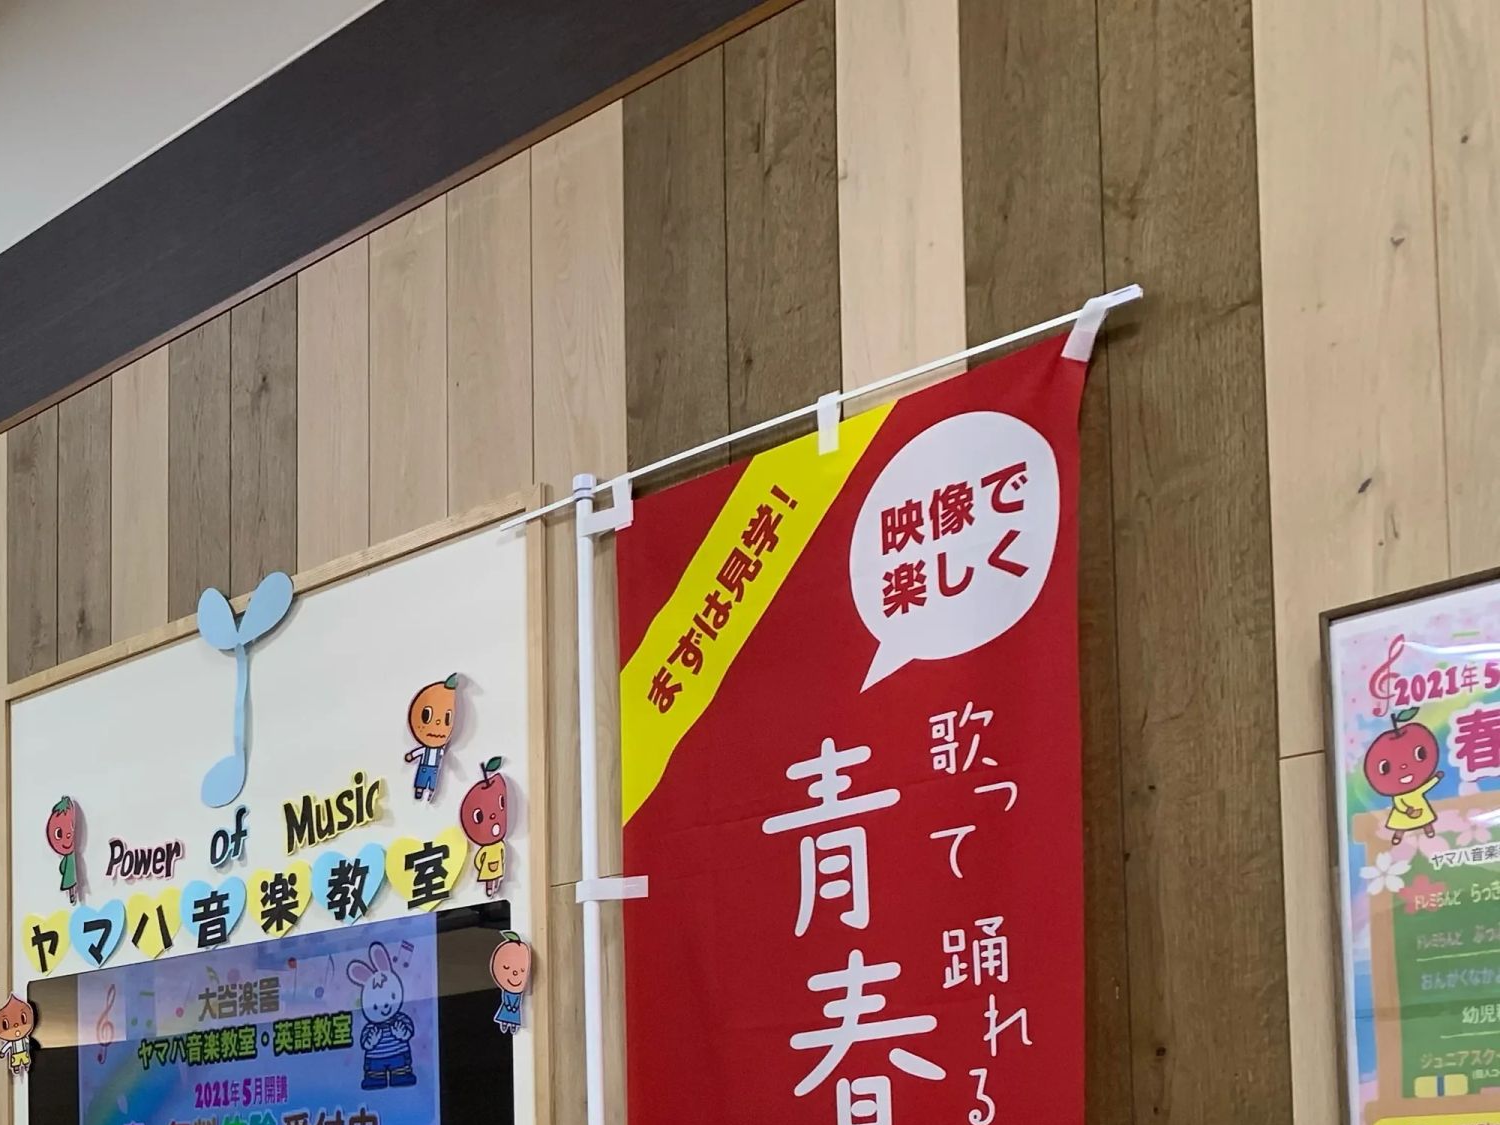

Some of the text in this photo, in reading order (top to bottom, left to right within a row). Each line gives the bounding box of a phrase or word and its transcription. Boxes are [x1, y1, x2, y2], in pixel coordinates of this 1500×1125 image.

[880, 461, 1029, 556] 映像で
[647, 484, 800, 716] まずは見学!
[882, 528, 1030, 618] 楽しく
[106, 770, 383, 879] Power of Music
[928, 700, 1019, 879] 歌って
[1431, 845, 1500, 867] ヤマハ音楽
[30, 840, 452, 974] ヤマハ音楽教室
[137, 1013, 353, 1072] ヤマハ音楽教室・英語教室
[1462, 1003, 1500, 1024] 幼児
[194, 1075, 288, 1109] 2021年5月開講
